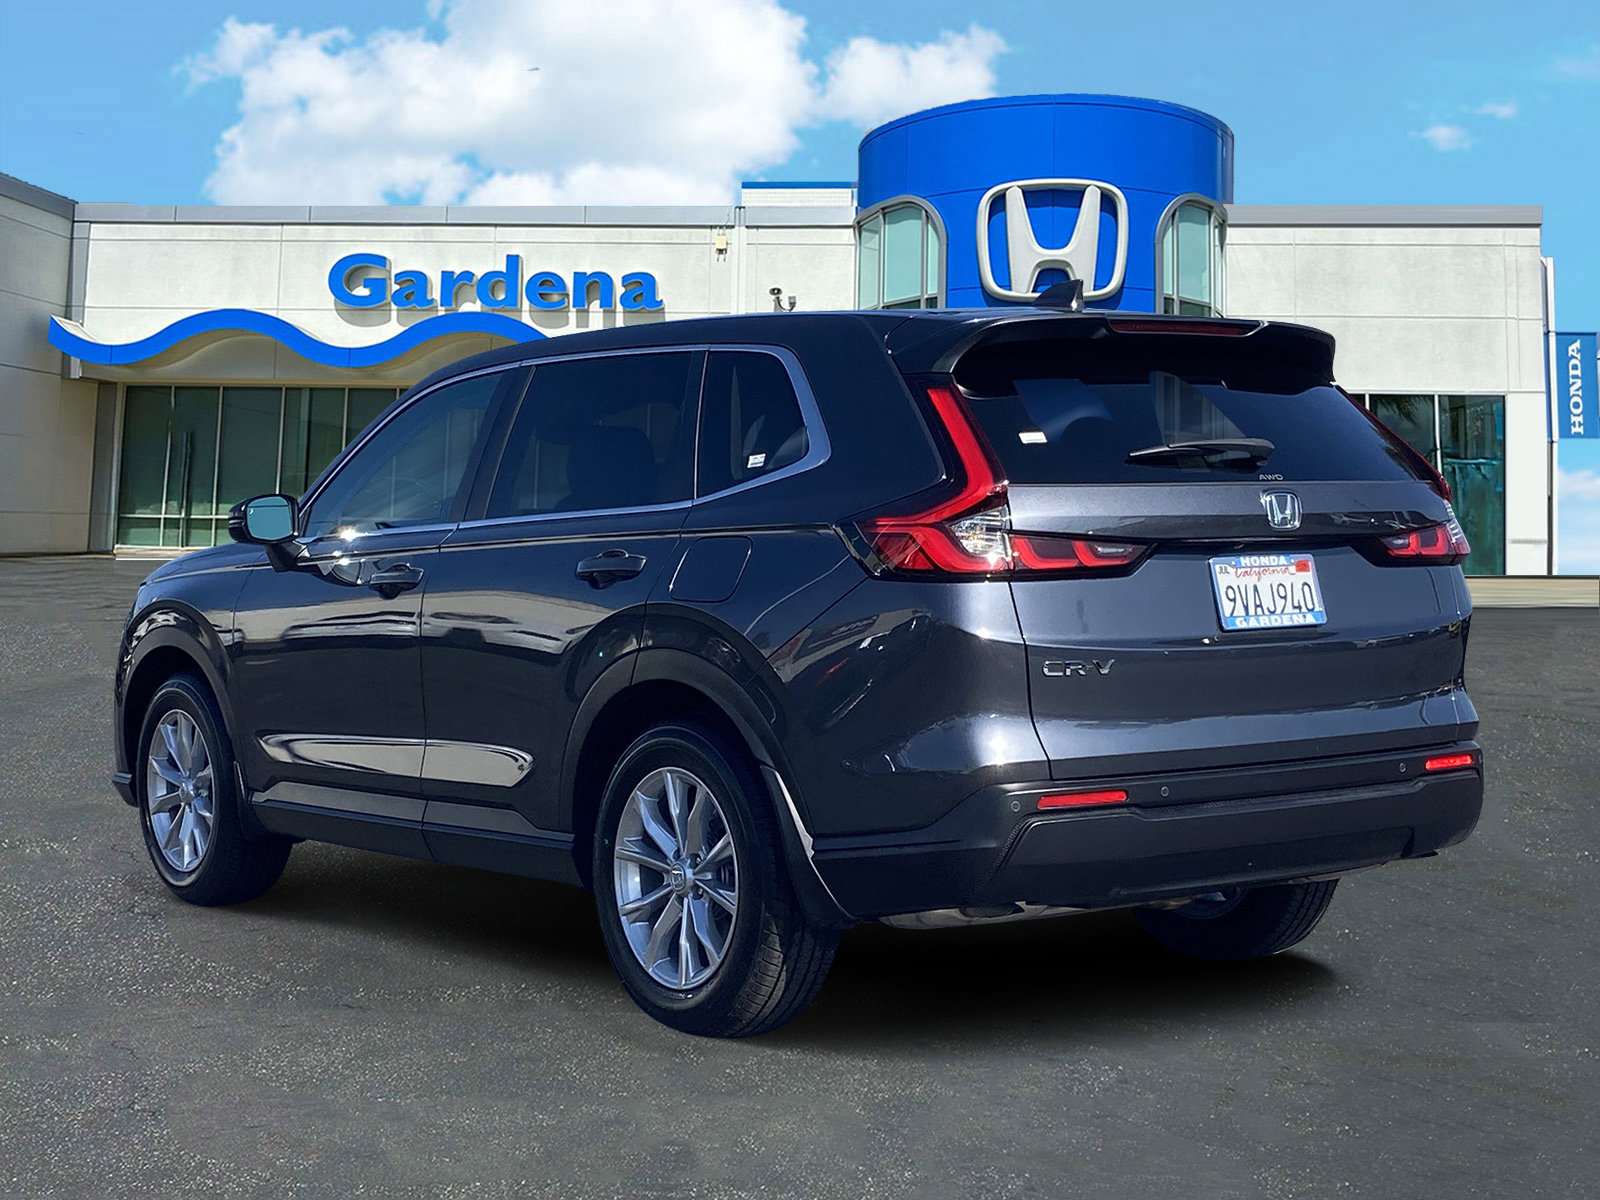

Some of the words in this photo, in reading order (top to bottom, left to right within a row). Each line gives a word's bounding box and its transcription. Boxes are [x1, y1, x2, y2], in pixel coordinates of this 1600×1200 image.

[327, 252, 664, 311] Gardena
[1567, 338, 1584, 435] HONDA
[1259, 473, 1284, 481] AWD
[1239, 555, 1288, 567] HONDA
[1234, 566, 1296, 582] California
[1225, 581, 1316, 617] 9VAJ940
[1235, 612, 1316, 628] GARDENA
